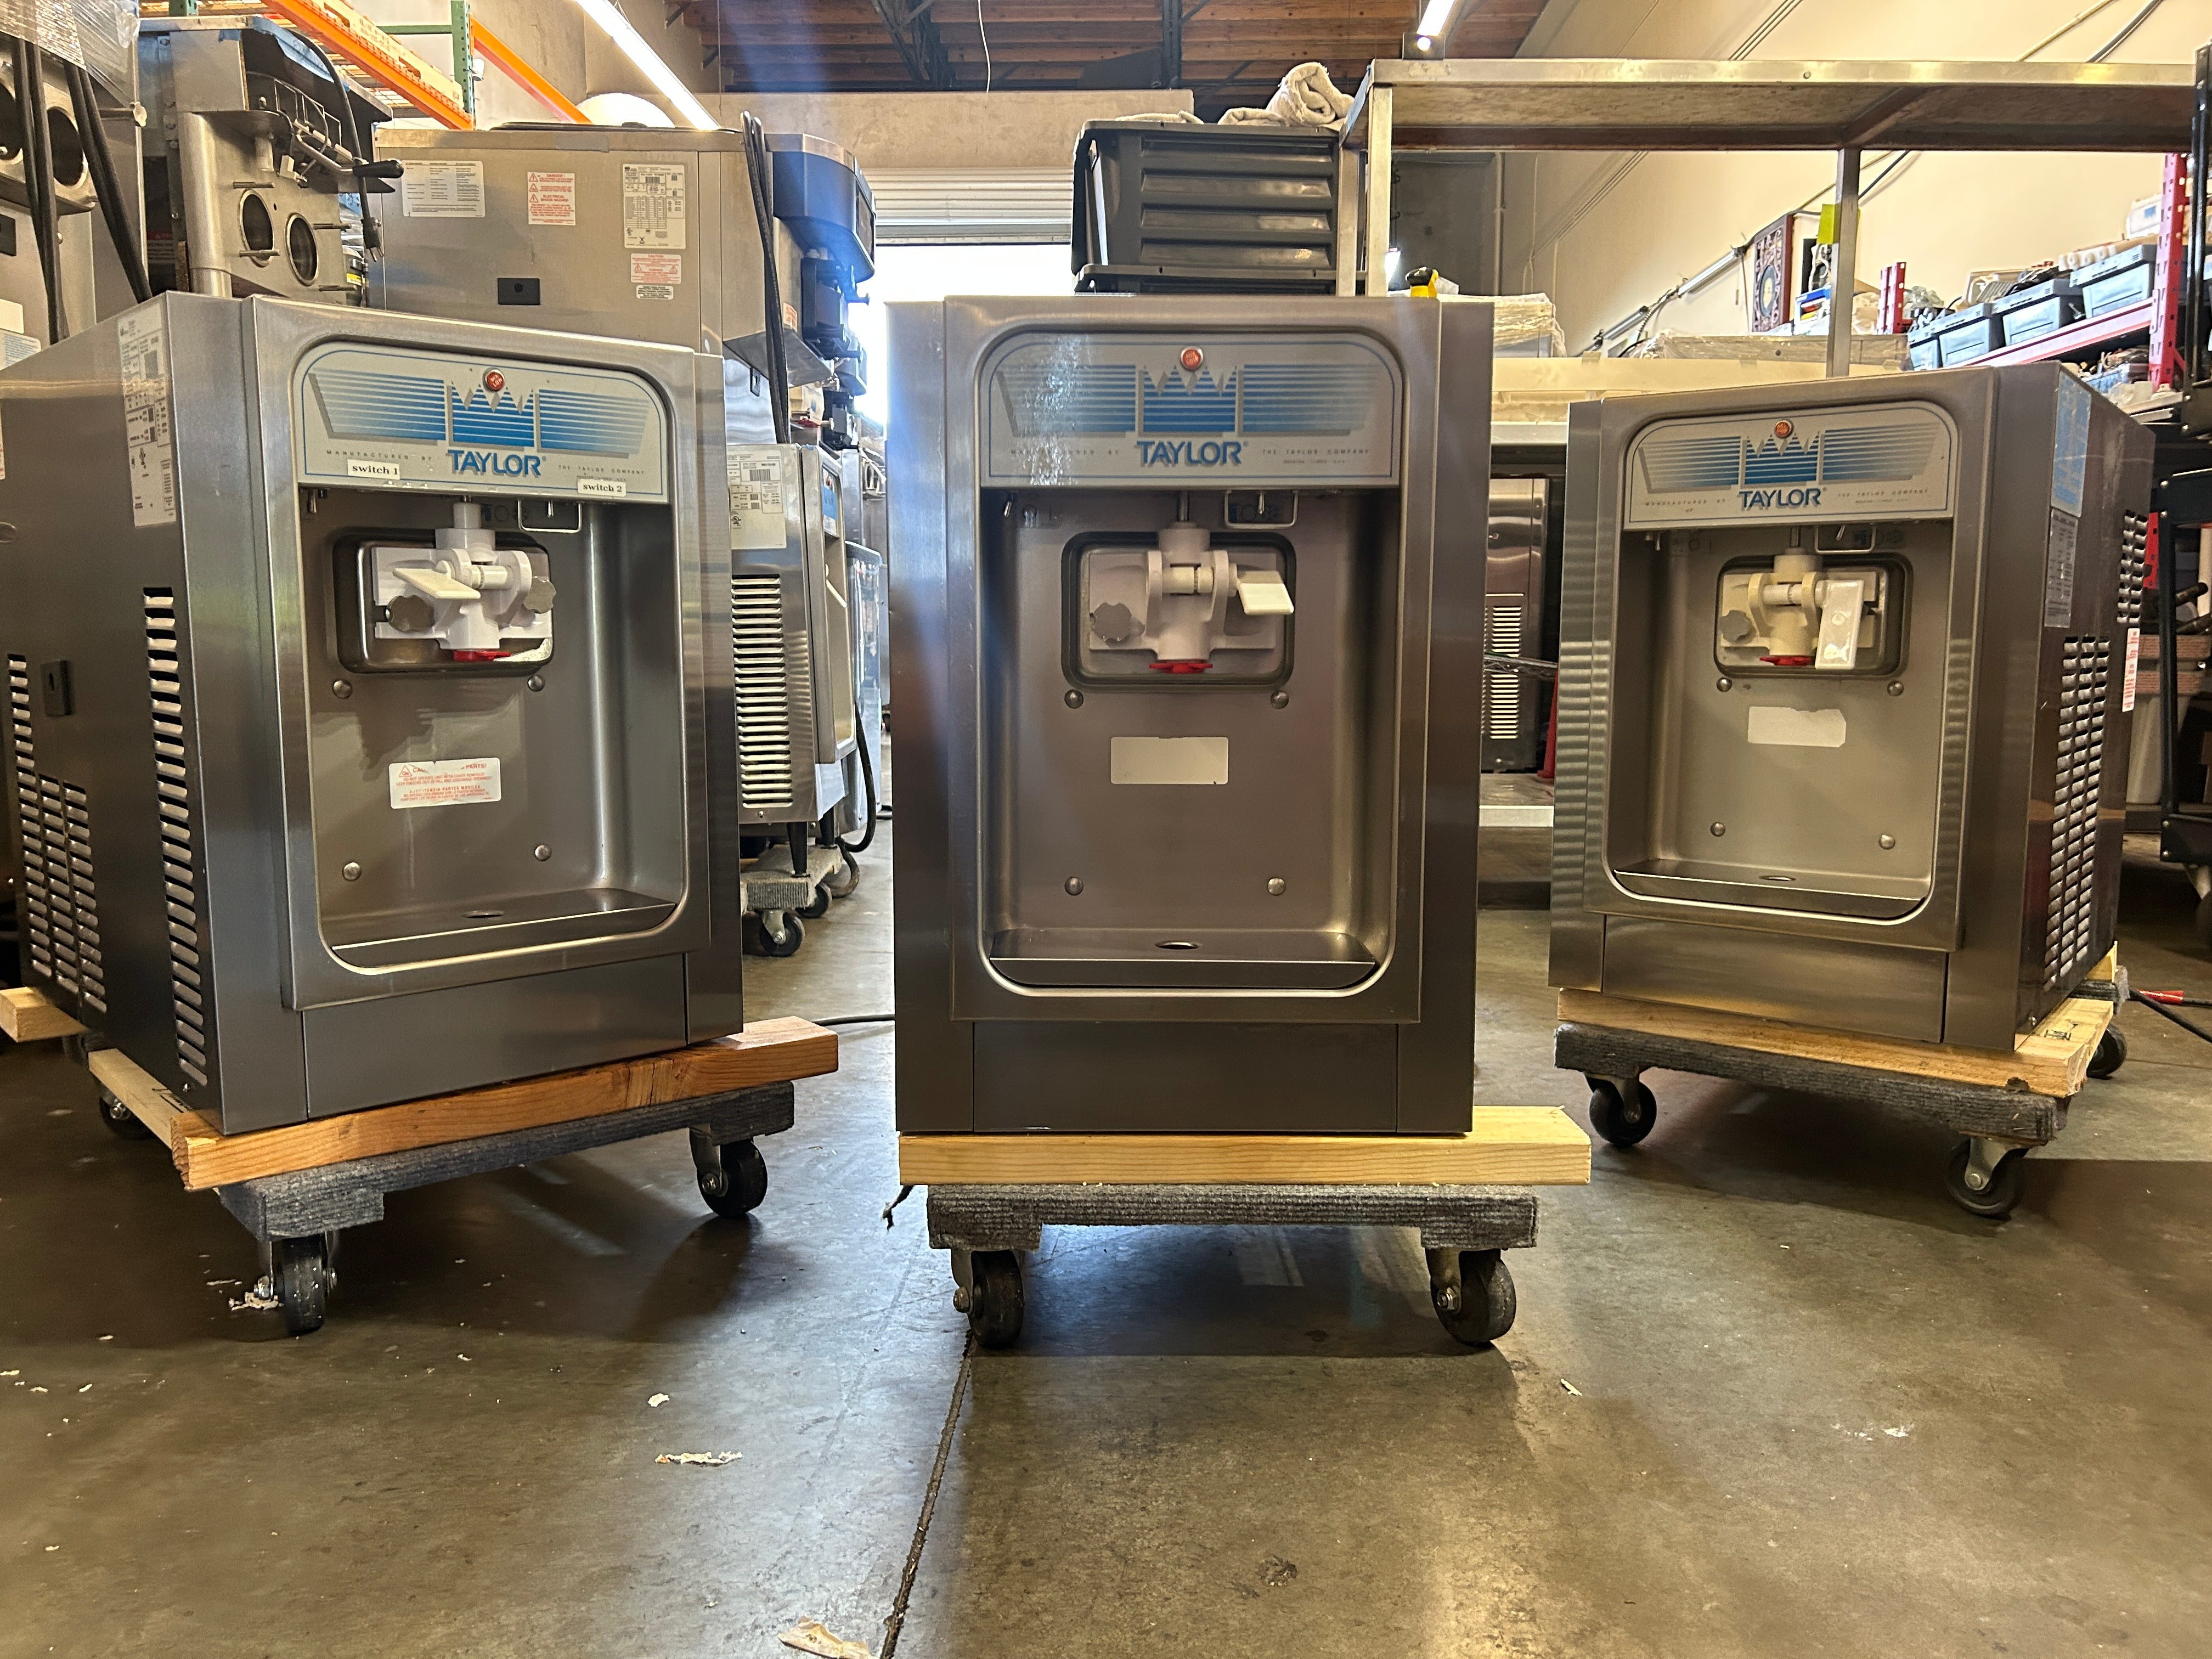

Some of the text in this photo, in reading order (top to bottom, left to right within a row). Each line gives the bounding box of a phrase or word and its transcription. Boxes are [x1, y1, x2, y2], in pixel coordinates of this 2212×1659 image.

[326, 450, 409, 460] MANUFACTURED
[1137, 441, 1242, 465] TAYLOR
[352, 465, 390, 475] switch
[447, 449, 541, 476] TAYLOR
[583, 483, 614, 492] switch
[1739, 488, 1821, 508] TAYLOR
